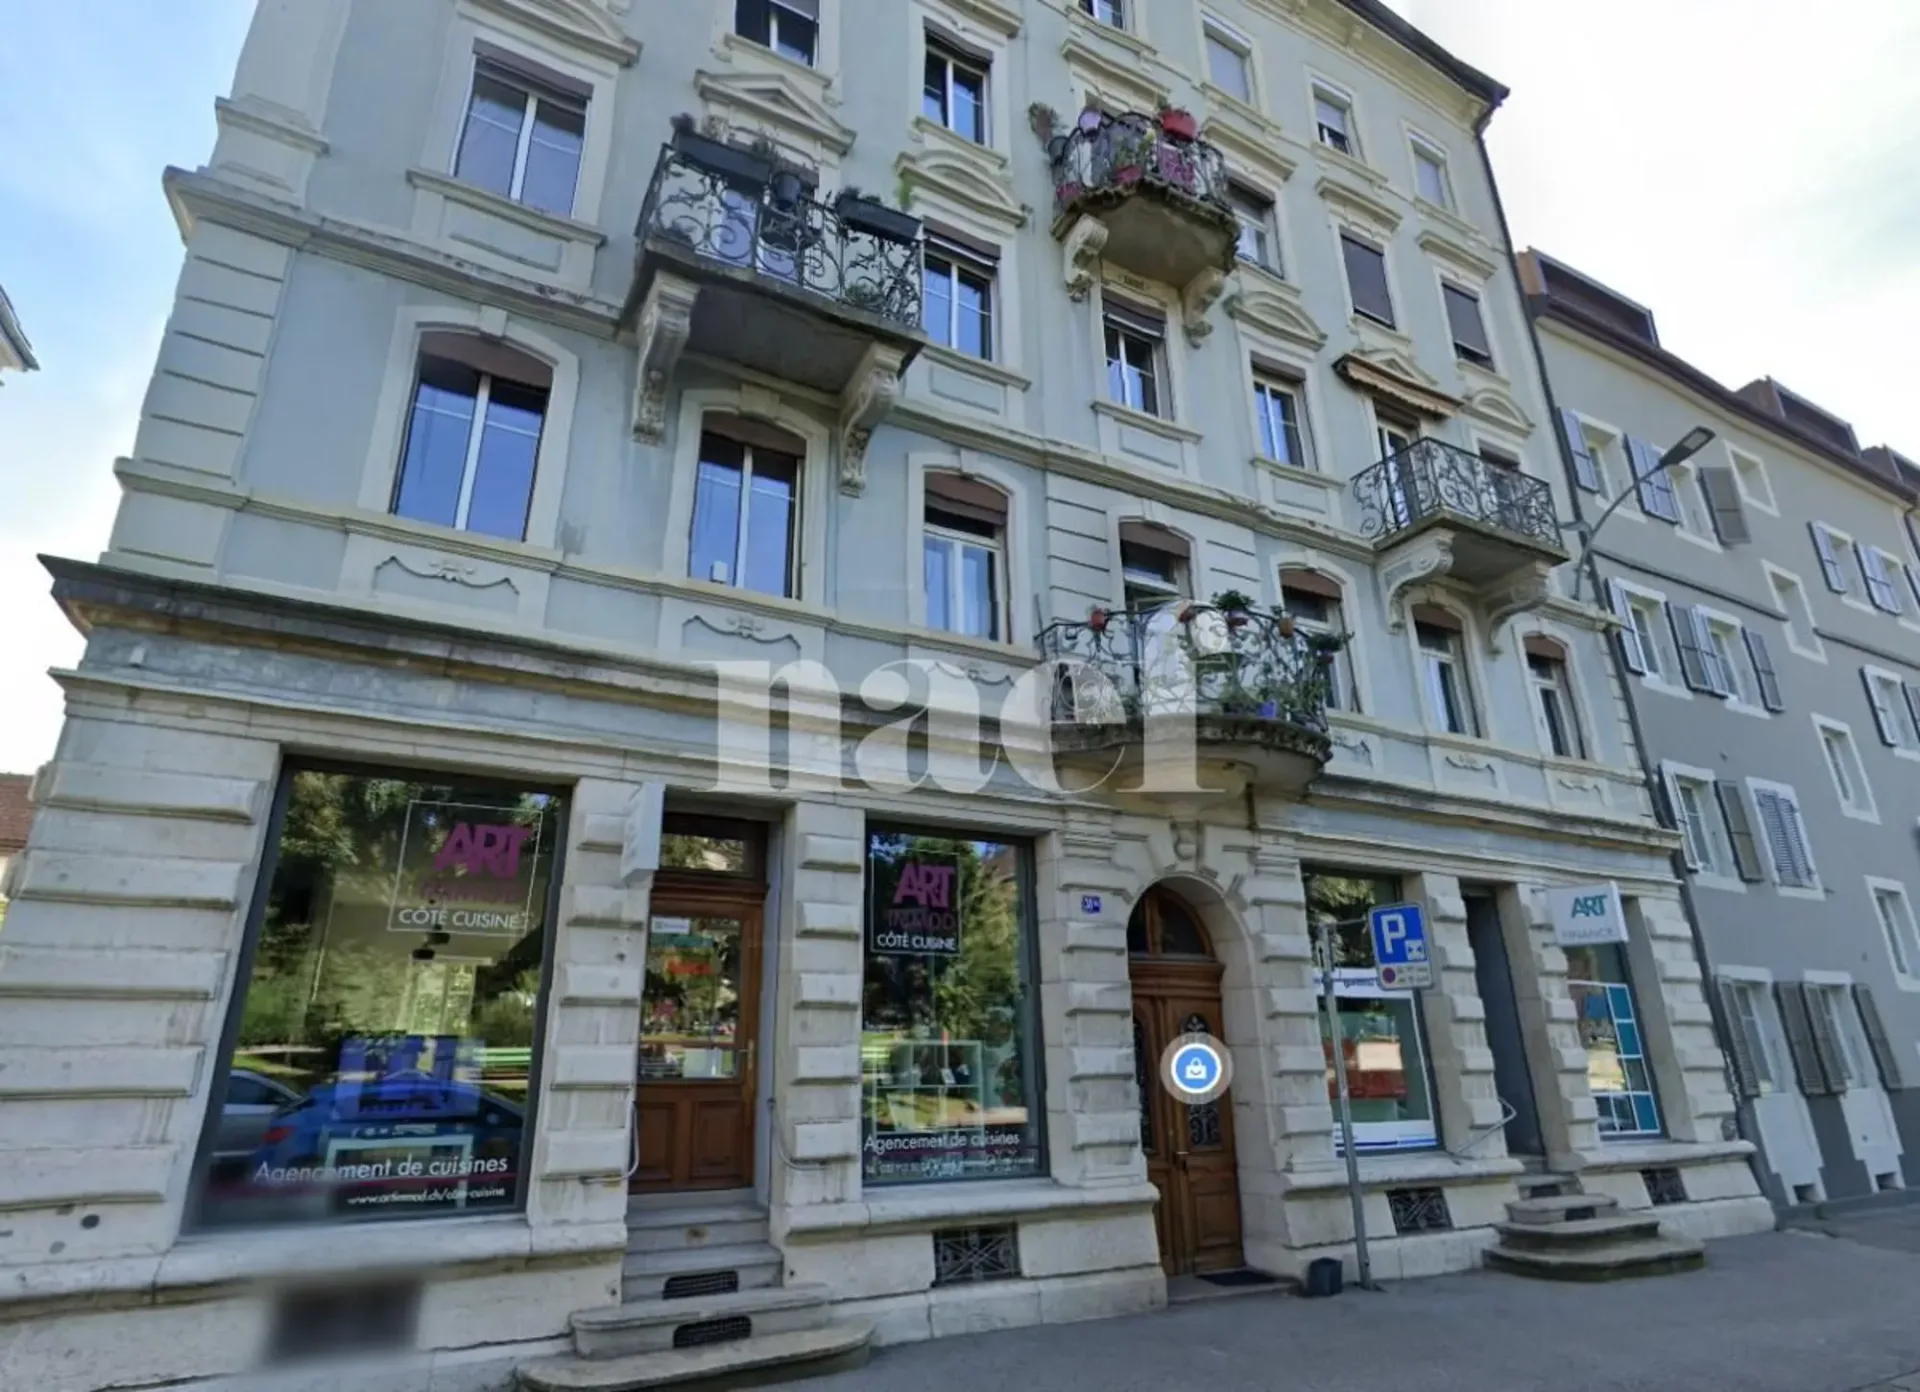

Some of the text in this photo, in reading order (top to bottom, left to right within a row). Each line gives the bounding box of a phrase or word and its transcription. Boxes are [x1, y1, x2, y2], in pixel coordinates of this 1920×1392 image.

[434, 822, 533, 880] ART
[892, 862, 956, 908] ART
[452, 911, 521, 929] CUISINE
[1571, 893, 1608, 918] ART
[1381, 914, 1406, 954] P
[864, 1130, 1020, 1154] Agencement de cuisines
[253, 1153, 509, 1187] Agencement de cuisines
